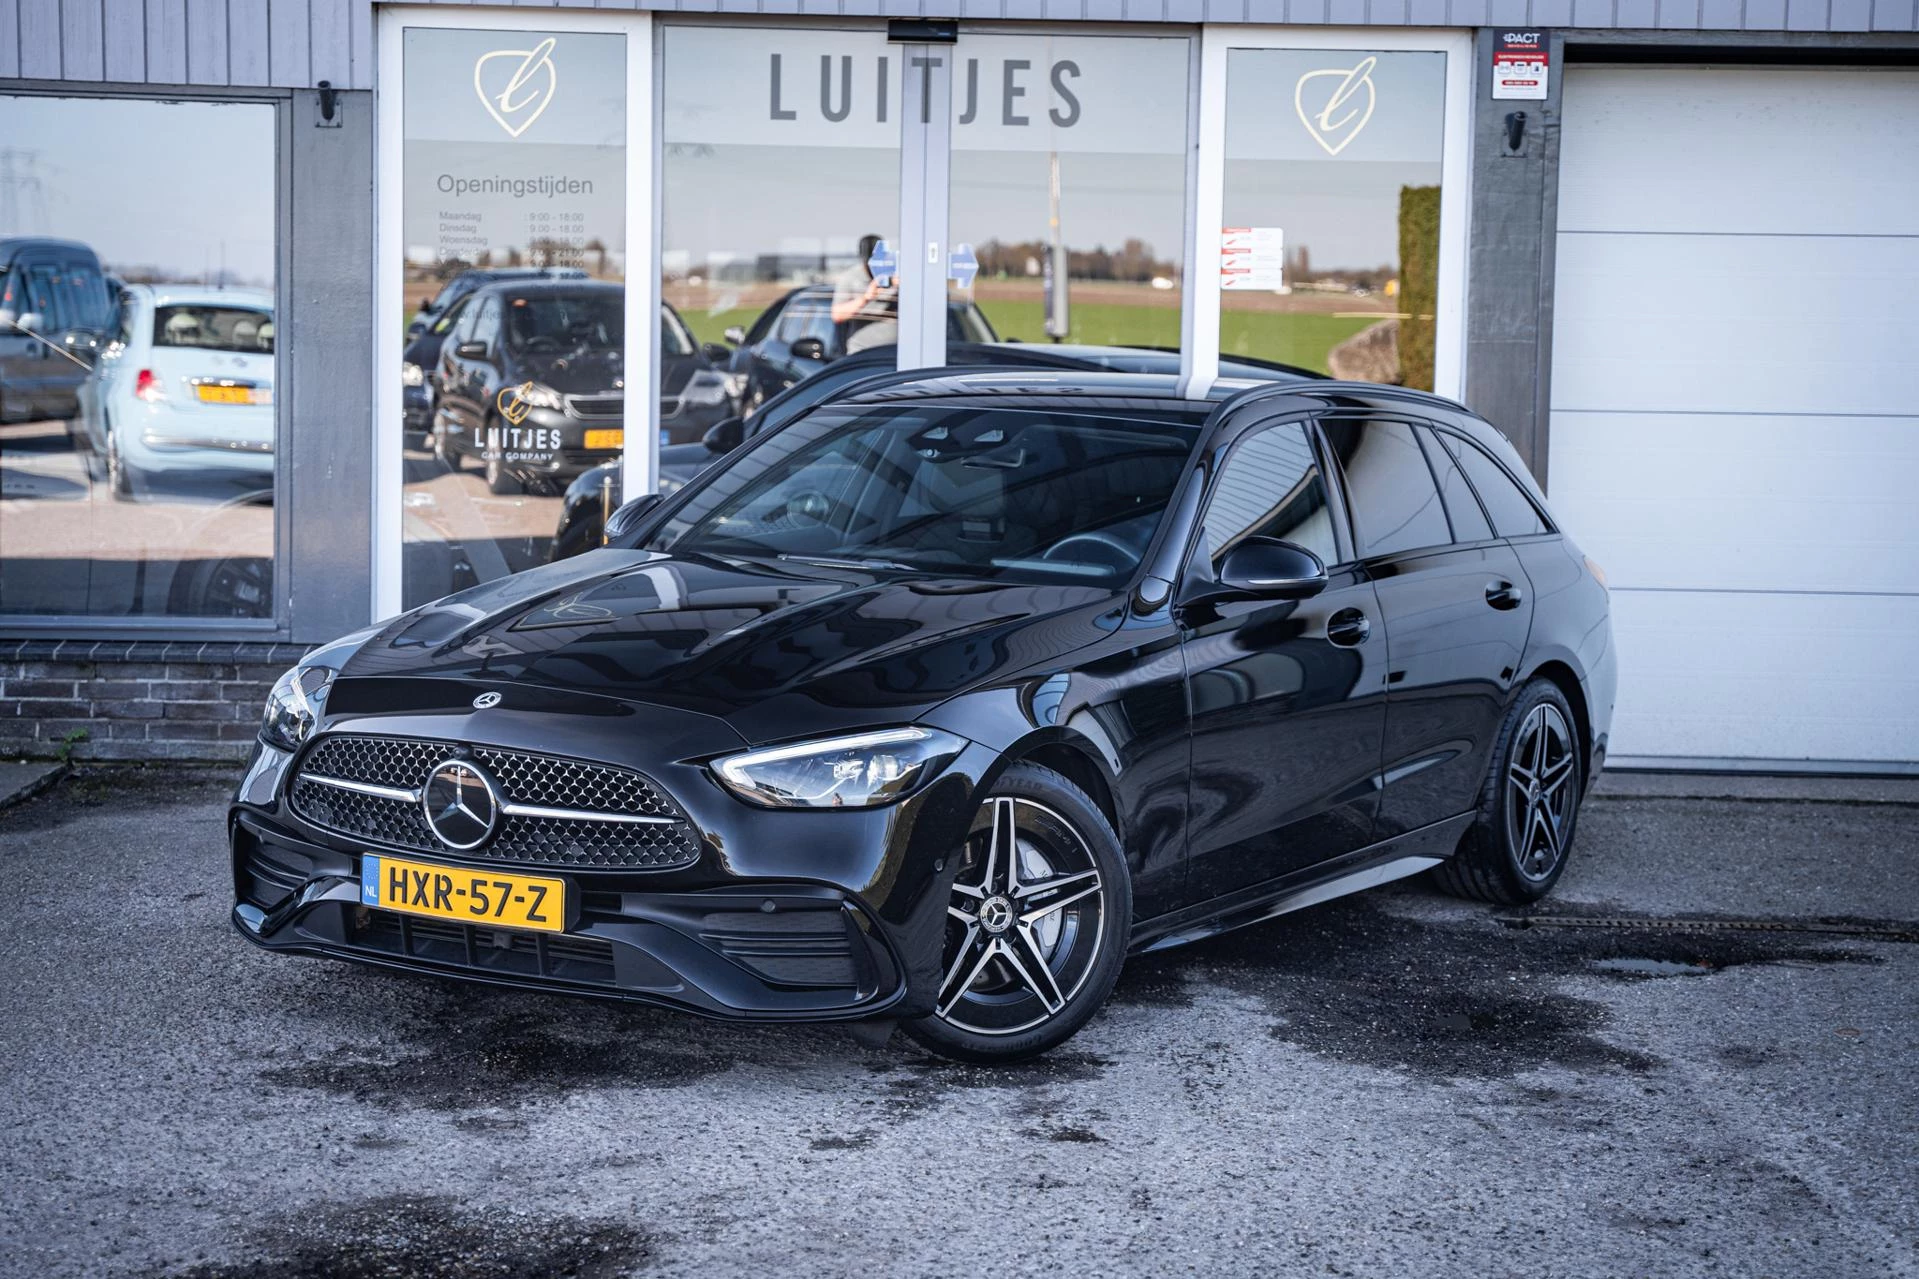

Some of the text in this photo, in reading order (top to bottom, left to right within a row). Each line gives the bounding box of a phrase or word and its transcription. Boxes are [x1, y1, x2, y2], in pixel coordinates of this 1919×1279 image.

[770, 54, 1081, 128] LUITJES
[437, 174, 593, 198] Openingstijden
[475, 427, 561, 449] LUITJES
[481, 451, 553, 460] CAR COMPANY
[365, 885, 377, 898] NL
[389, 867, 548, 923] HXR-57-Z
